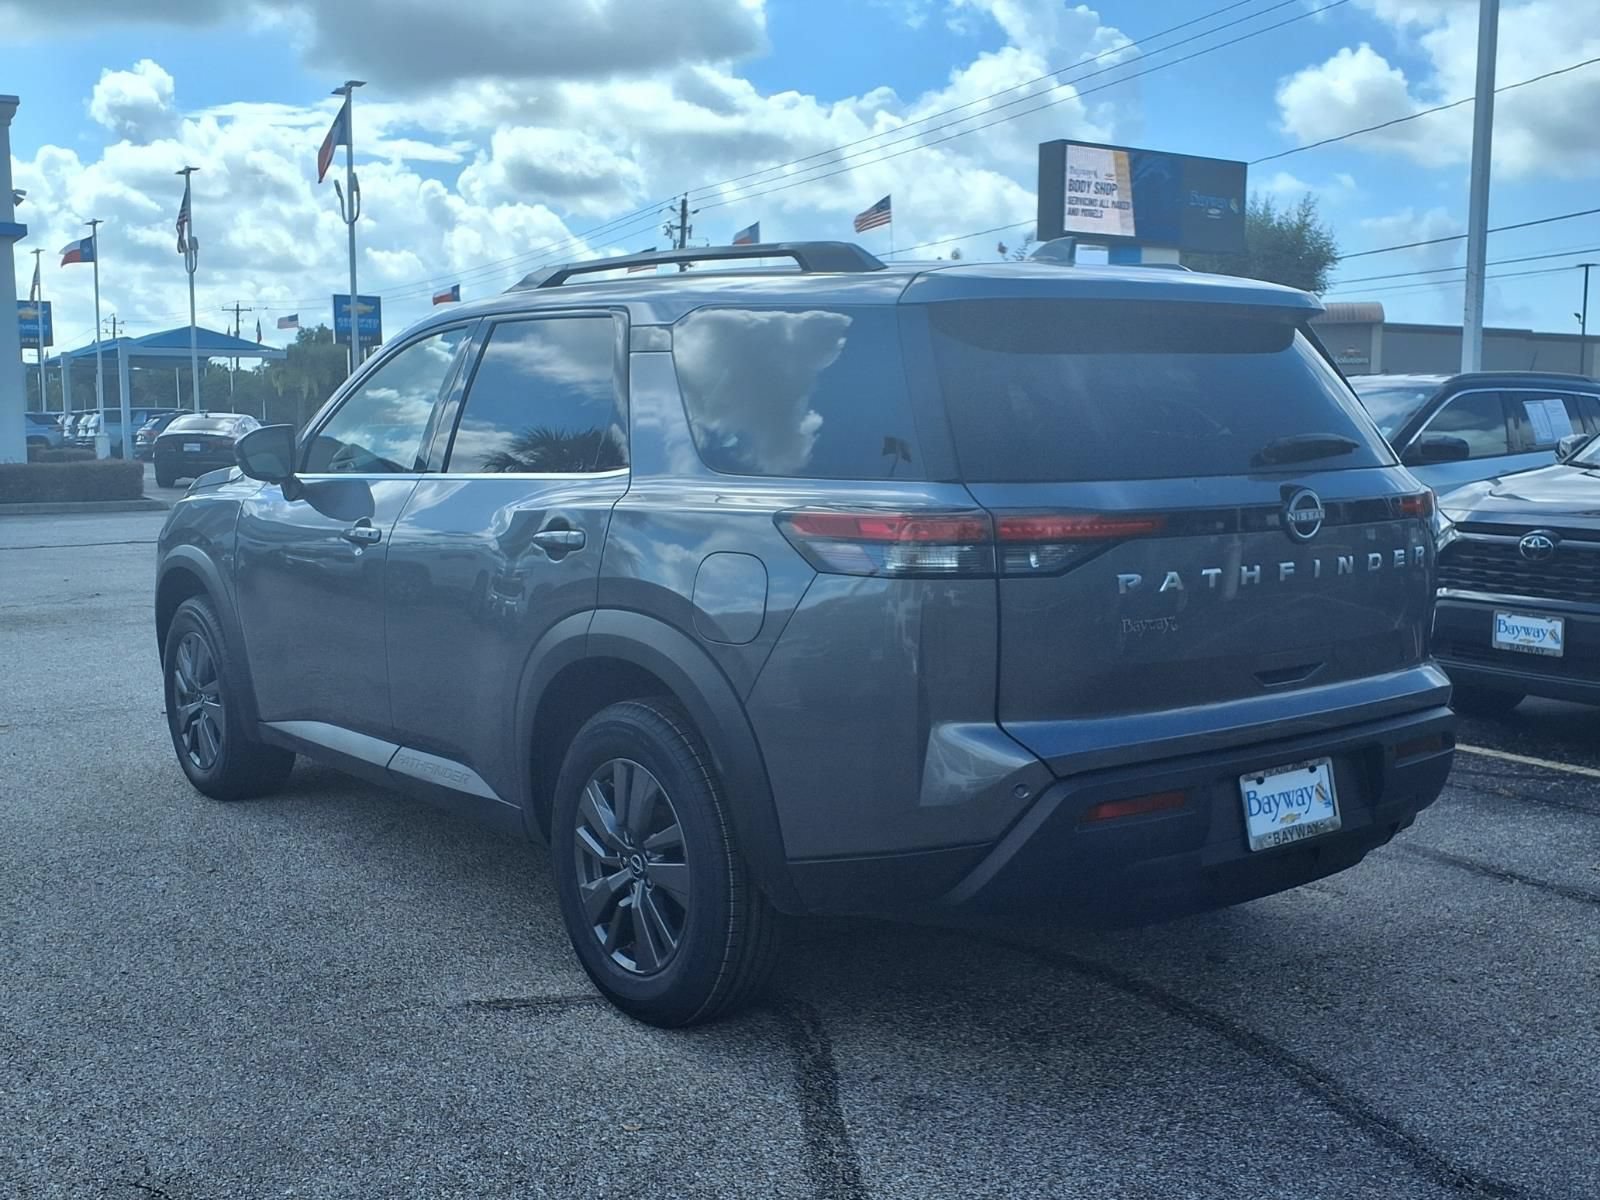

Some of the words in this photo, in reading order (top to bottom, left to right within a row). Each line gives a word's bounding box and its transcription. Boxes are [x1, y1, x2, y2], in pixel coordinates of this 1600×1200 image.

[1068, 178, 1092, 194] BODY
[1094, 181, 1118, 197] SHOP
[1287, 509, 1325, 521] NISSAN
[1116, 545, 1426, 594] PATHFINDER
[1497, 619, 1548, 643] Bayway
[1246, 785, 1315, 823] Bayway
[1273, 822, 1320, 845] BAYWAY
